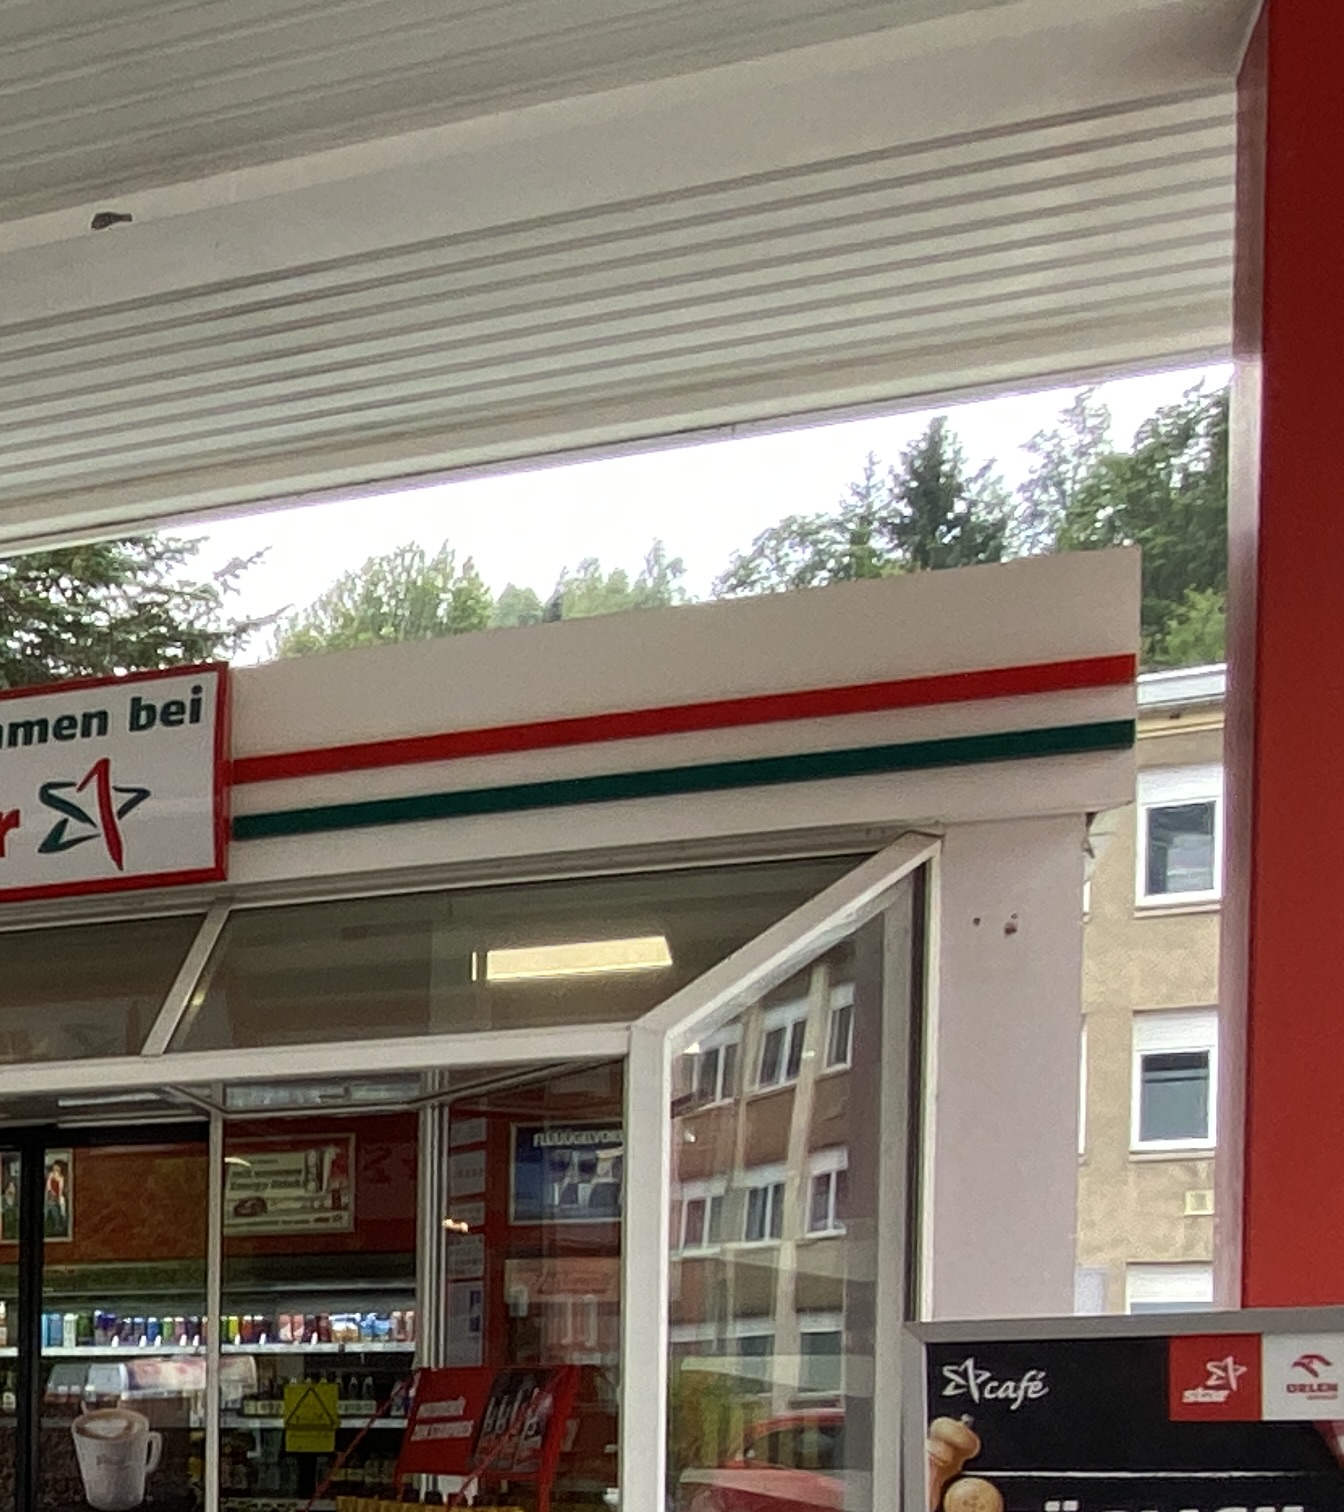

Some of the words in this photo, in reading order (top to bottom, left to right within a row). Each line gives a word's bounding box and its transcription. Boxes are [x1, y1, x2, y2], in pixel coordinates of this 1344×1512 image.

[129, 685, 203, 732] bei
[984, 1369, 1050, 1410] café
[1286, 1383, 1339, 1393] ORLEN
